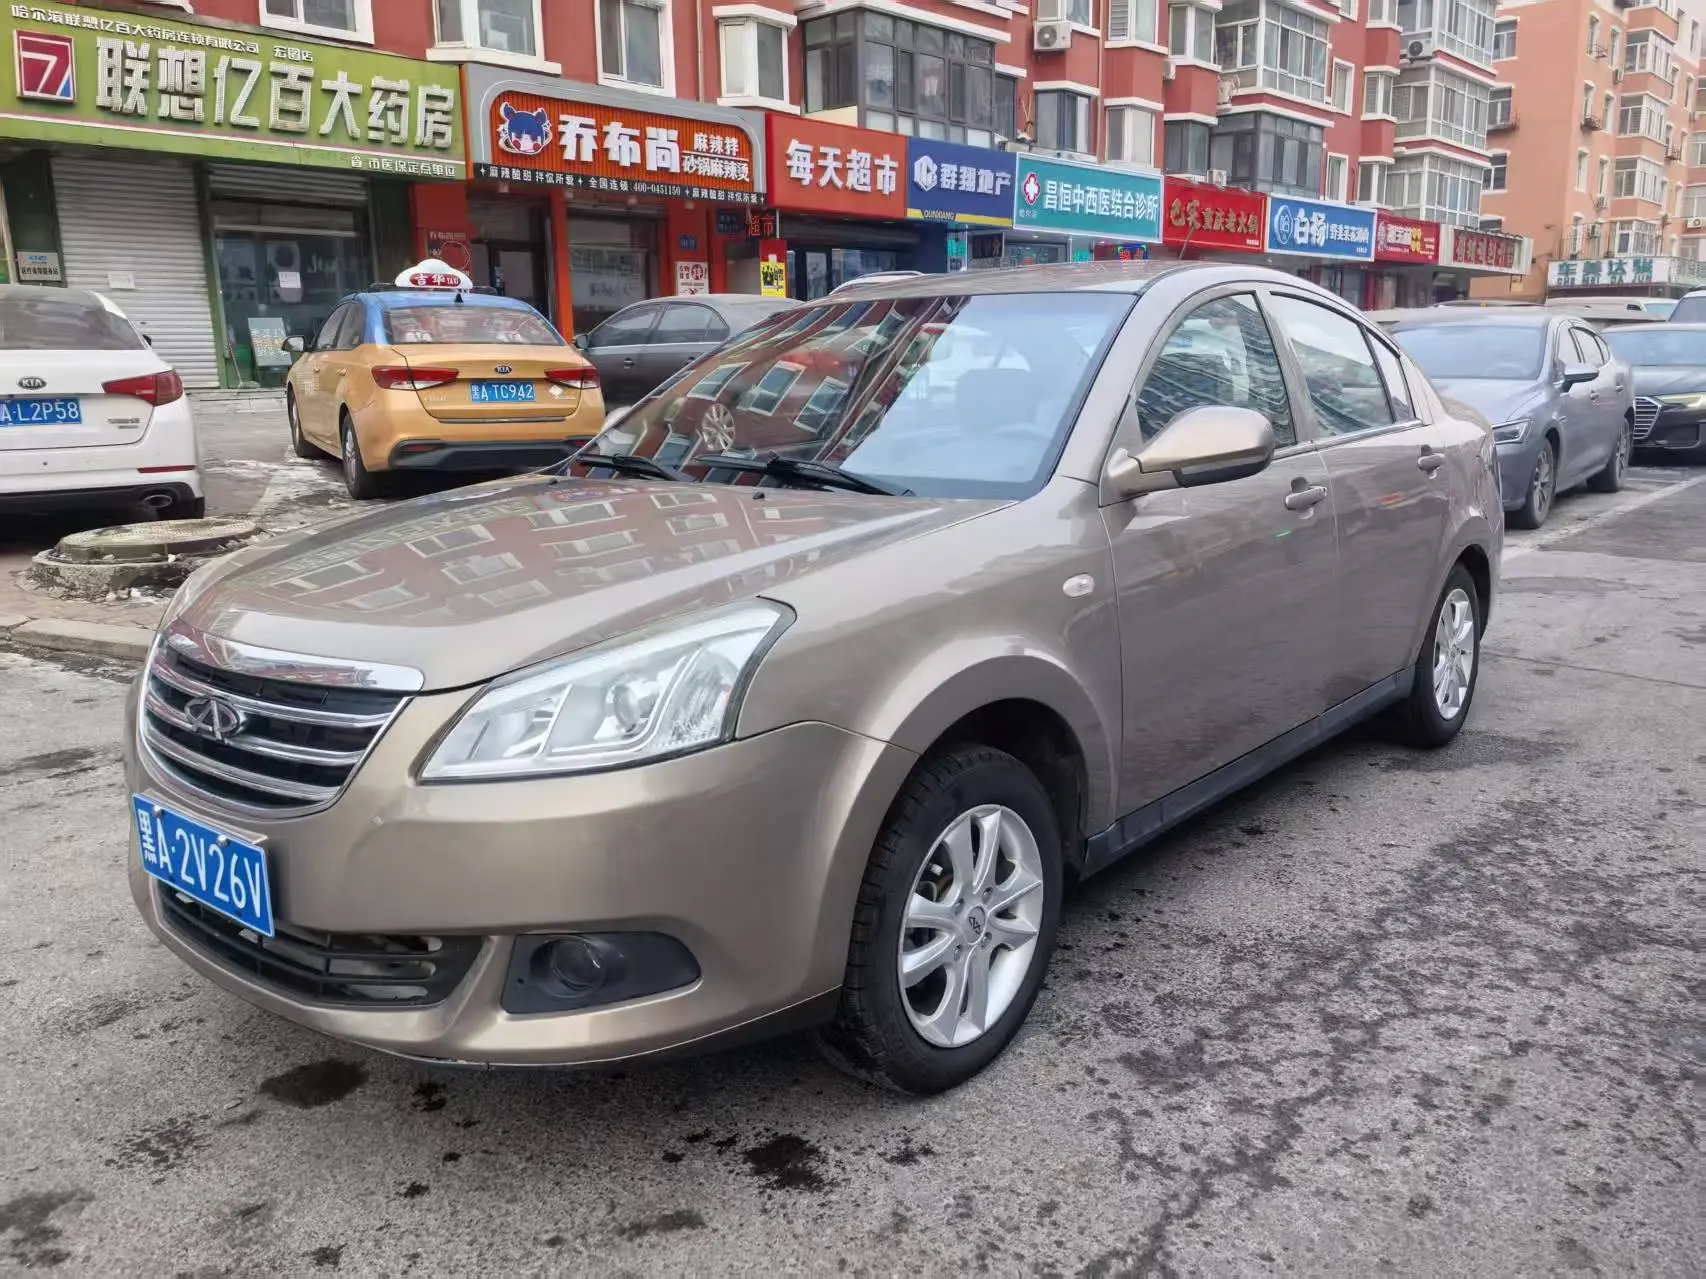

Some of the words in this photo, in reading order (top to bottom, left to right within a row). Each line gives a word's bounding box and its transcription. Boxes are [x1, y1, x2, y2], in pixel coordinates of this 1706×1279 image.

[96, 36, 455, 149] 联想亿百大药房
[558, 114, 680, 173] 乔布尚
[694, 132, 738, 156] 麻辣拌
[682, 155, 750, 182] 砂锅麻辣烫
[785, 138, 899, 196] 每天超市
[415, 273, 446, 286] 吉华
[447, 277, 459, 286] TAXI
[21, 378, 43, 388] KIA
